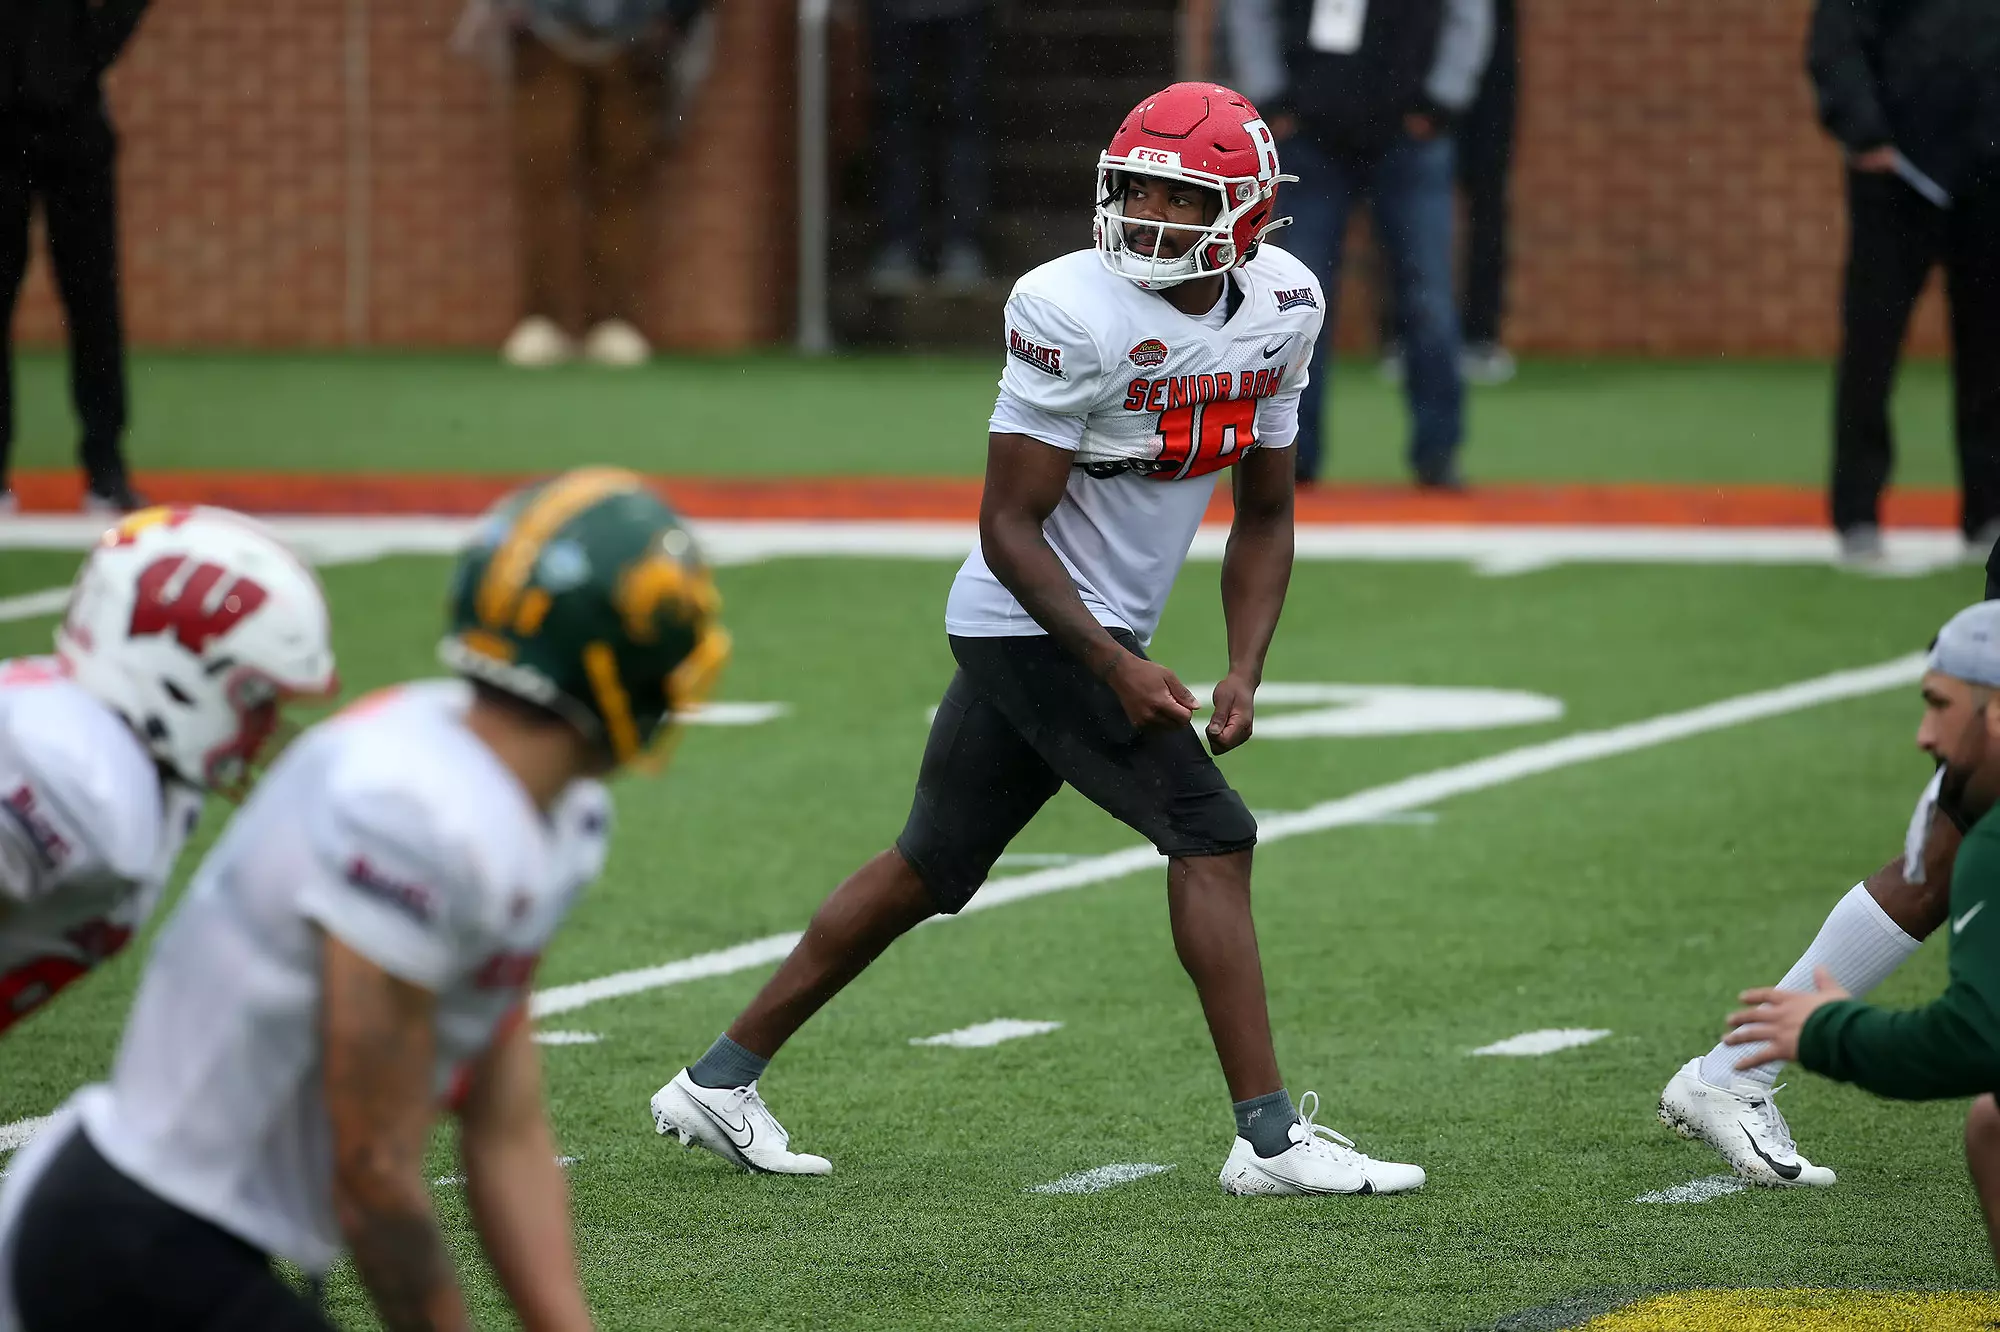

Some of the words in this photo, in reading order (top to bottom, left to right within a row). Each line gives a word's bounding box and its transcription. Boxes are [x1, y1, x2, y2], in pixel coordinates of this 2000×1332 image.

[1137, 150, 1168, 165] FTC
[1242, 118, 1280, 181] R
[1123, 372, 1232, 411] SENIOR
[1239, 362, 1288, 398] BOW
